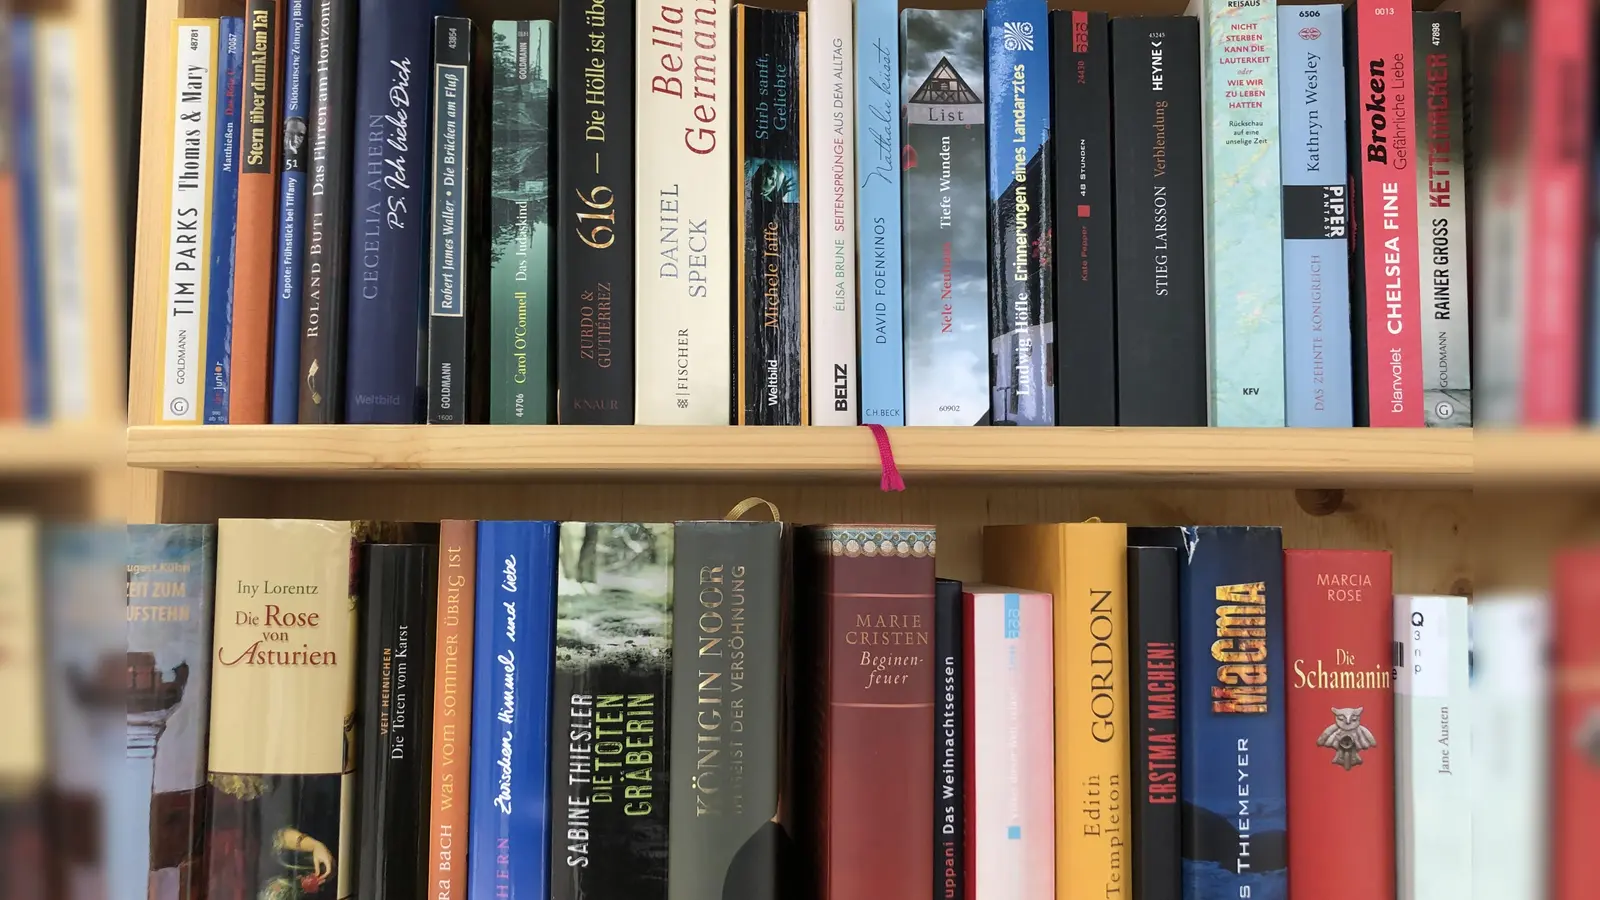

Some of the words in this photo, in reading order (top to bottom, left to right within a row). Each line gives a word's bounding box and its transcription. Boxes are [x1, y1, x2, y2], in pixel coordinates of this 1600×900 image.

[253, 10, 269, 31] Tal
[1231, 23, 1258, 31] NICHT
[1298, 10, 1321, 18] 6506
[1374, 8, 1395, 16] 0013
[190, 29, 199, 51] 48781
[227, 33, 238, 54] 70057
[317, 0, 331, 72] Horizont
[448, 28, 458, 49] 43854
[586, 31, 606, 54] ist
[652, 5, 683, 100] Bella
[1224, 45, 1249, 53] KANN
[1226, 34, 1263, 42] STERBEN
[1431, 22, 1441, 47] 47898
[251, 31, 269, 91] dunklem
[519, 42, 528, 80] GOLDMANN
[832, 38, 844, 80] ALLTAG
[1151, 49, 1165, 91] HEYNE
[1219, 56, 1271, 65] LAUTERKEIT
[1304, 51, 1321, 105] Wesley
[181, 64, 208, 103] Mary
[317, 76, 329, 102] am
[389, 57, 412, 108] Dich
[445, 73, 459, 98] Fluß
[585, 58, 606, 107] Hölle
[772, 64, 787, 131] Geliebte
[833, 82, 844, 109] DEM
[1227, 79, 1244, 87] WIE
[180, 111, 201, 123] &
[249, 92, 265, 124] über
[447, 101, 458, 118] am
[834, 112, 844, 136] AUS
[928, 107, 964, 122] List
[1012, 64, 1028, 143] Landarztes
[1229, 101, 1263, 109] HATTEN
[1366, 58, 1388, 165] Broken
[222, 121, 234, 173] Matthießen
[247, 127, 264, 165] Stern
[313, 105, 328, 161] Flirren
[384, 109, 409, 152] liebe
[444, 120, 456, 165] Brücken
[585, 110, 606, 143] Die
[1152, 100, 1169, 178] Verblendung
[1305, 109, 1323, 172] Kathryn
[178, 129, 201, 192] Thomas
[367, 112, 385, 192] AHERN
[939, 135, 951, 192] Wunden
[1011, 147, 1028, 183] eines
[1079, 138, 1087, 180] STUNDEN
[286, 177, 298, 207] Tiffany
[312, 164, 326, 197] Das
[383, 156, 411, 190] Ich
[443, 171, 455, 187] Die
[832, 138, 845, 232] SEITENSPRÜNGE
[1079, 183, 1087, 197] 48
[285, 208, 295, 222] bei
[387, 196, 408, 230] P.S.
[443, 200, 455, 236] Waller
[575, 185, 615, 249] 616
[940, 196, 951, 229] Tiefe
[1154, 185, 1169, 250] LARSSON
[1322, 186, 1331, 238] FANTASY
[1329, 186, 1345, 238] PIPER
[1382, 182, 1400, 231] FINE
[175, 207, 199, 272] PARKS
[283, 223, 295, 265] Frühstück
[310, 211, 323, 255] BUTI
[516, 201, 528, 258] Judaskind
[659, 184, 679, 280] DANIEL
[763, 221, 781, 258] Jaffe
[1012, 186, 1030, 282] Erinnerungen
[1432, 218, 1450, 265] GROSS
[362, 201, 381, 300] CECELIA
[442, 239, 455, 270] James
[516, 260, 528, 282] Das
[688, 218, 707, 298] SPECK
[834, 239, 845, 278] BRUNE
[874, 217, 886, 296] FOENKINOS
[941, 240, 952, 300] Neuhaus
[282, 265, 294, 300] Capote:
[441, 273, 454, 309] Robert
[1156, 255, 1169, 296] STIEG
[1384, 236, 1403, 335] CHELSEA
[1434, 269, 1451, 320] RAINER
[173, 282, 195, 317] TIM
[307, 262, 321, 338] ROLAND
[763, 263, 780, 330] Michele
[832, 281, 846, 312] ÉLISA
[1014, 292, 1031, 333] Höfle
[514, 292, 527, 350] O'Connell
[875, 302, 887, 344] DAVID
[941, 303, 953, 334] Nele
[176, 329, 187, 385] GOLDMANN
[514, 353, 527, 384] Carol
[677, 328, 689, 390] FISCHER
[1016, 338, 1034, 396] Ludwig
[1438, 331, 1449, 388] GOLDMANN
[441, 362, 452, 409] GOLDMANN
[767, 359, 778, 406] Weltbild
[834, 363, 848, 412] BELTZ
[1242, 387, 1260, 396] KFV
[1390, 347, 1405, 413] blanvalet
[515, 393, 525, 418] 44706
[237, 580, 260, 599] Iny
[263, 580, 319, 595] Lorentz
[501, 554, 517, 593] liebe
[1316, 573, 1372, 587] MARCIA
[235, 611, 260, 626] Die
[263, 604, 319, 627] Rose
[698, 564, 724, 658] NOOR
[1327, 589, 1362, 602] ROSE
[262, 631, 289, 641] von
[394, 624, 408, 658] Karst
[503, 601, 516, 643] und
[727, 565, 745, 693] VERSÖHNUNG
[845, 631, 929, 646] CRISTEN
[855, 614, 921, 628] MARIE
[381, 648, 392, 707] HEINICHEN
[395, 662, 407, 690] vom
[1089, 587, 1114, 743] GORDON
[1293, 659, 1390, 689] Schamanin
[1336, 648, 1355, 666] Die
[497, 649, 515, 725] Himmel
[864, 669, 909, 690] feuer
[1147, 641, 1176, 720] MACHEN!
[380, 711, 390, 735] VEIT
[392, 693, 406, 733] Toten
[594, 694, 624, 772] TOTEN
[730, 698, 744, 732] DER
[942, 656, 955, 800] Weihnachtsessen
[1438, 706, 1450, 747] Austen
[391, 735, 405, 760] Die
[569, 693, 593, 786] THIESLER
[620, 693, 655, 816] GRÄBERIN
[691, 669, 722, 817] KÖNIGIN
[493, 730, 513, 815] Zwischen
[1438, 749, 1453, 776] Jane
[592, 774, 613, 803] DIE
[1082, 773, 1101, 838] Edith
[1237, 737, 1251, 874] THIEMEYER
[566, 795, 590, 868] SABINE
[943, 805, 955, 835] Das
